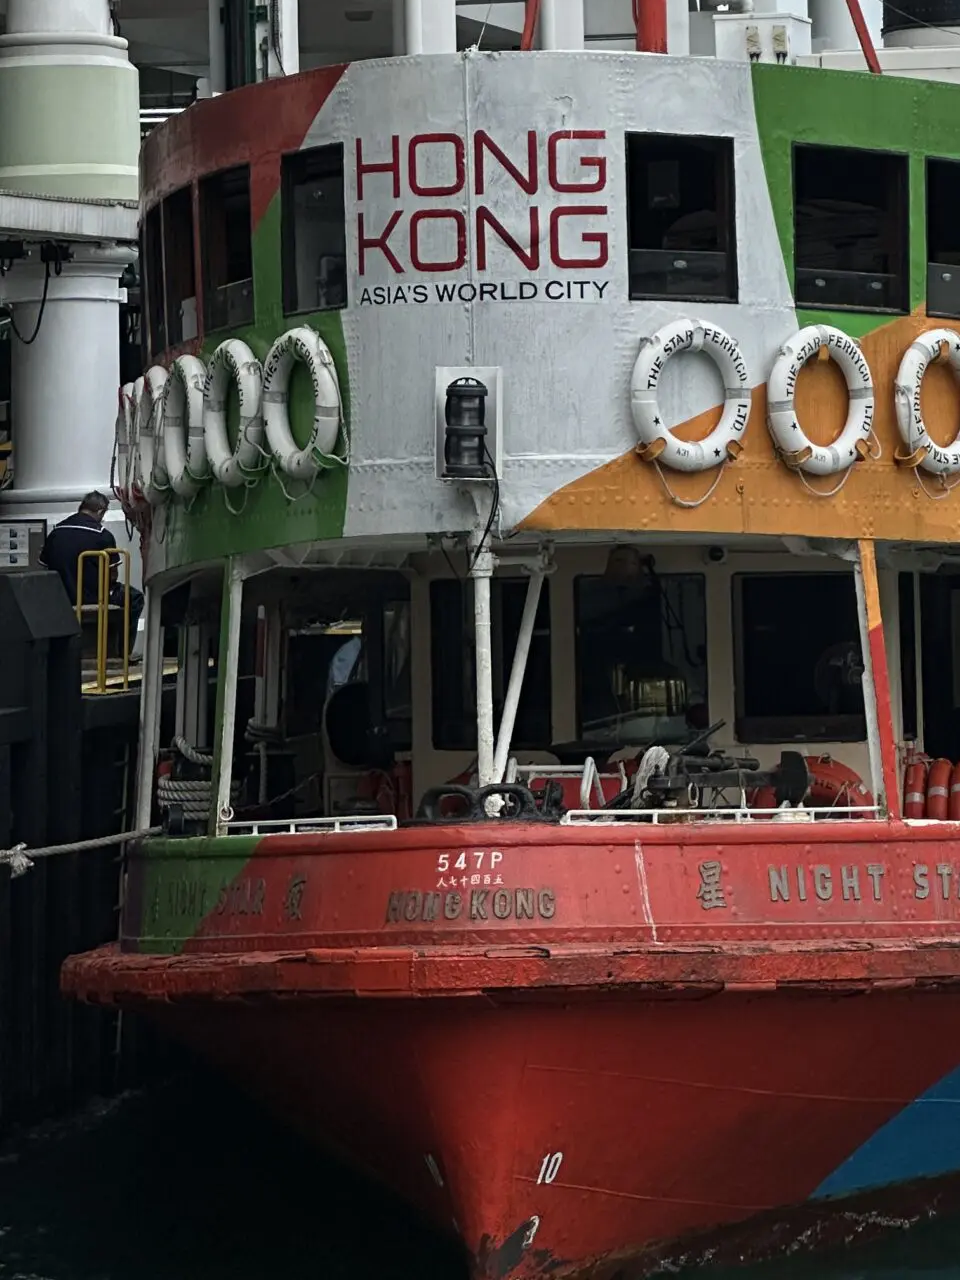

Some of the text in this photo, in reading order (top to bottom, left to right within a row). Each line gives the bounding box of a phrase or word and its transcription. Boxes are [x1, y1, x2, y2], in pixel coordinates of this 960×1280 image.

[355, 129, 607, 201] HONG
[357, 205, 609, 276] KONG
[359, 280, 610, 306] ASIA'S WORLD CITY
[263, 363, 278, 390] THE
[647, 356, 664, 389] THE
[663, 329, 694, 356] STAR
[703, 328, 741, 362] FERRY
[786, 364, 799, 397] THE
[796, 337, 821, 365] STAR
[828, 334, 863, 365] FERRY
[437, 851, 503, 872] 547P
[387, 887, 556, 923] HONG KONG
[697, 860, 728, 910] 星
[768, 864, 885, 902] NIGHT
[536, 1151, 563, 1185] 10
